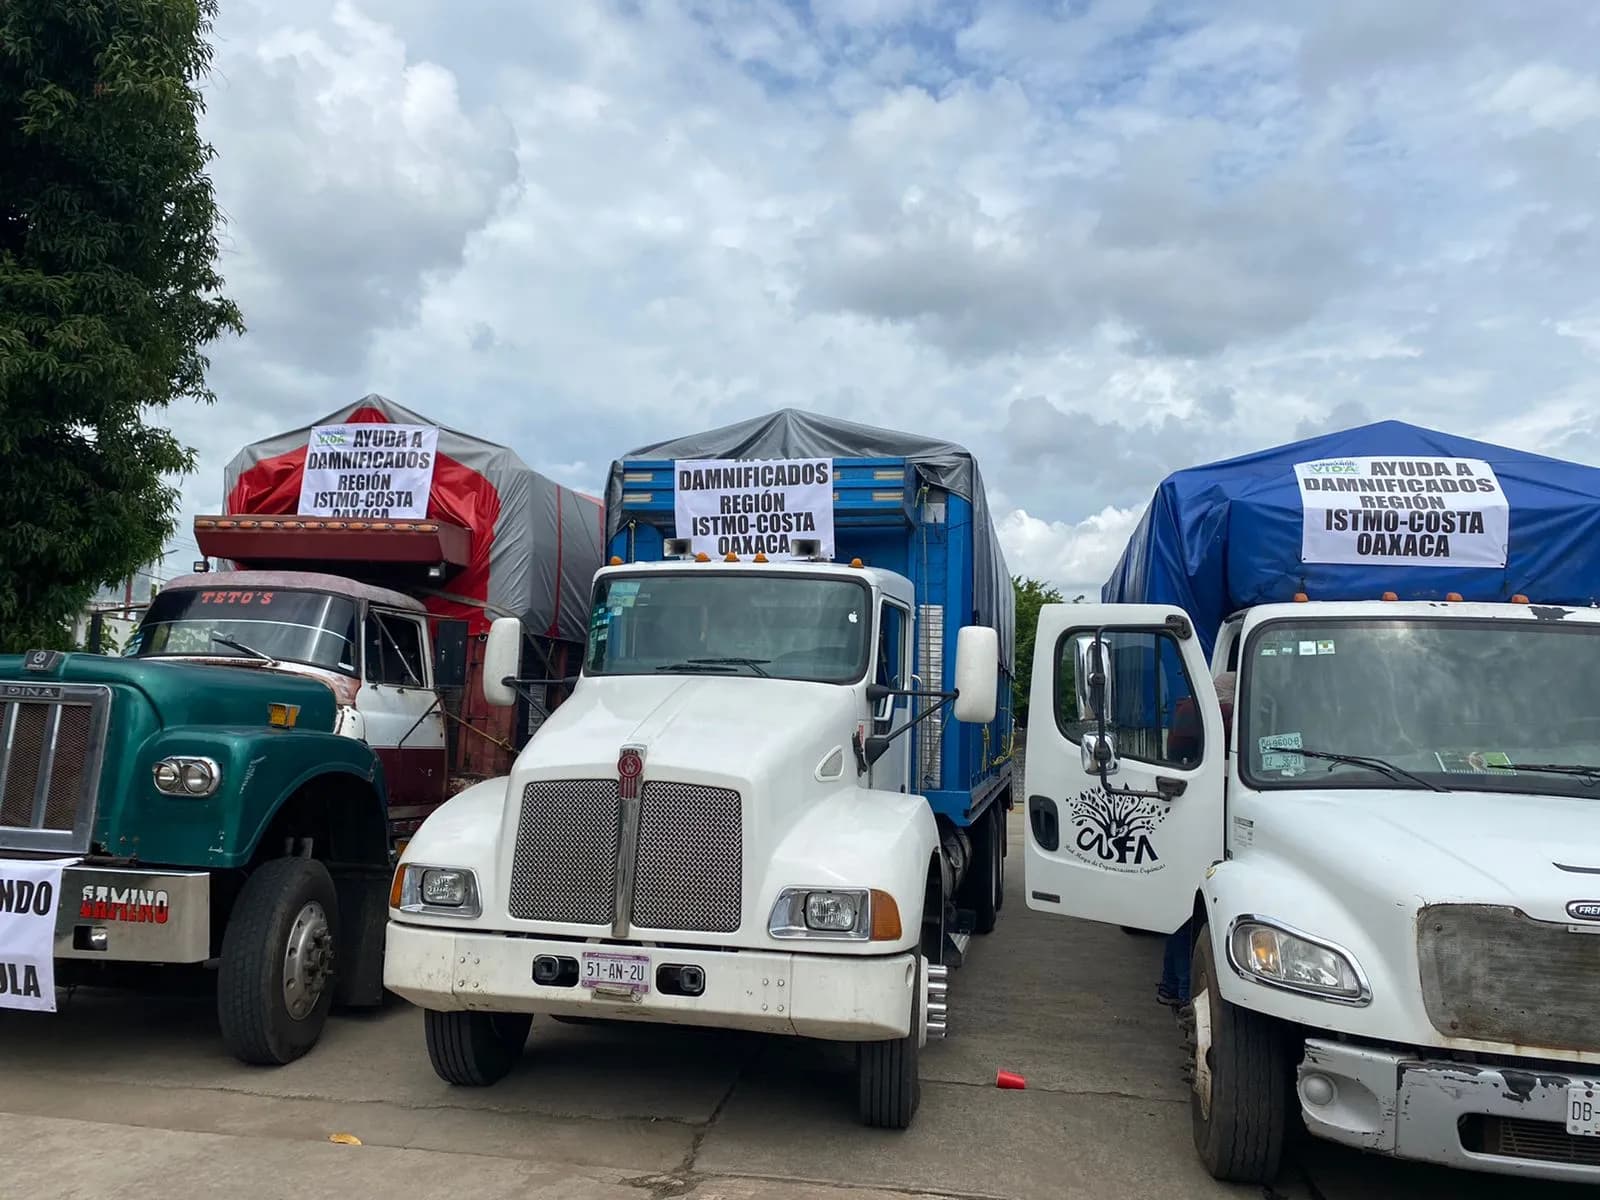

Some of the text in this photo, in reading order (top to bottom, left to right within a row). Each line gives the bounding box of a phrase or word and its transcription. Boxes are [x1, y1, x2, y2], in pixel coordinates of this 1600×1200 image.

[353, 430, 423, 448] AYUDA A
[308, 451, 430, 469] DAMNIFICADOS
[1371, 461, 1452, 477] AYUDA
[1456, 462, 1474, 477] A
[337, 471, 392, 491] REGIÓN
[679, 462, 828, 491] DAMNIFICADOS
[1303, 478, 1496, 493] DAMNIFICADOS
[313, 491, 413, 508] ISTMO-COSTA
[720, 489, 785, 515] REGIÓN
[1359, 494, 1446, 510] REGIÓN
[692, 511, 815, 537] ISTMO-COSTA
[1325, 508, 1485, 534] ISTMO-COSTA
[717, 534, 790, 556] OAXACA
[1357, 533, 1450, 558] OAXACA
[7, 687, 54, 697] DINA
[587, 961, 645, 981] 51-AN-2U
